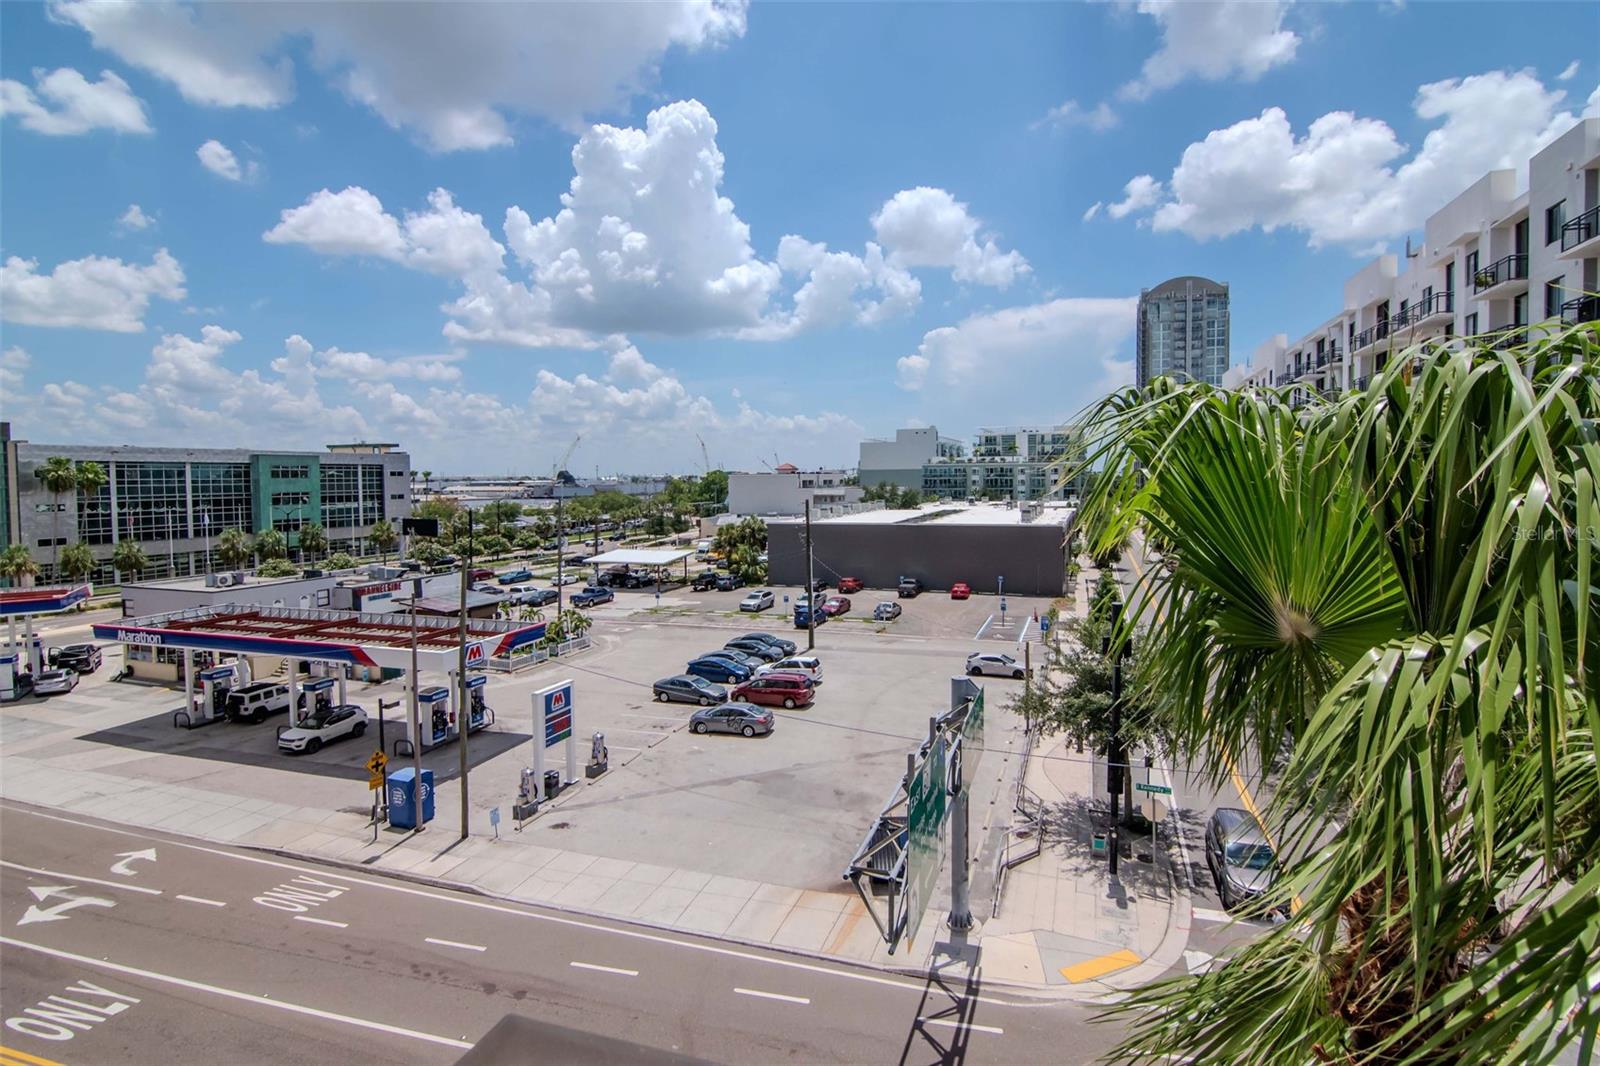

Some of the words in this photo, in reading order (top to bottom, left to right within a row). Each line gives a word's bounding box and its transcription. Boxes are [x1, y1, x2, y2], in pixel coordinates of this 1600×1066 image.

[118, 629, 161, 644] Marathon
[468, 644, 481, 660] M
[553, 693, 563, 706] M
[252, 874, 351, 912] ONLY
[5, 980, 141, 1041] ONLY
